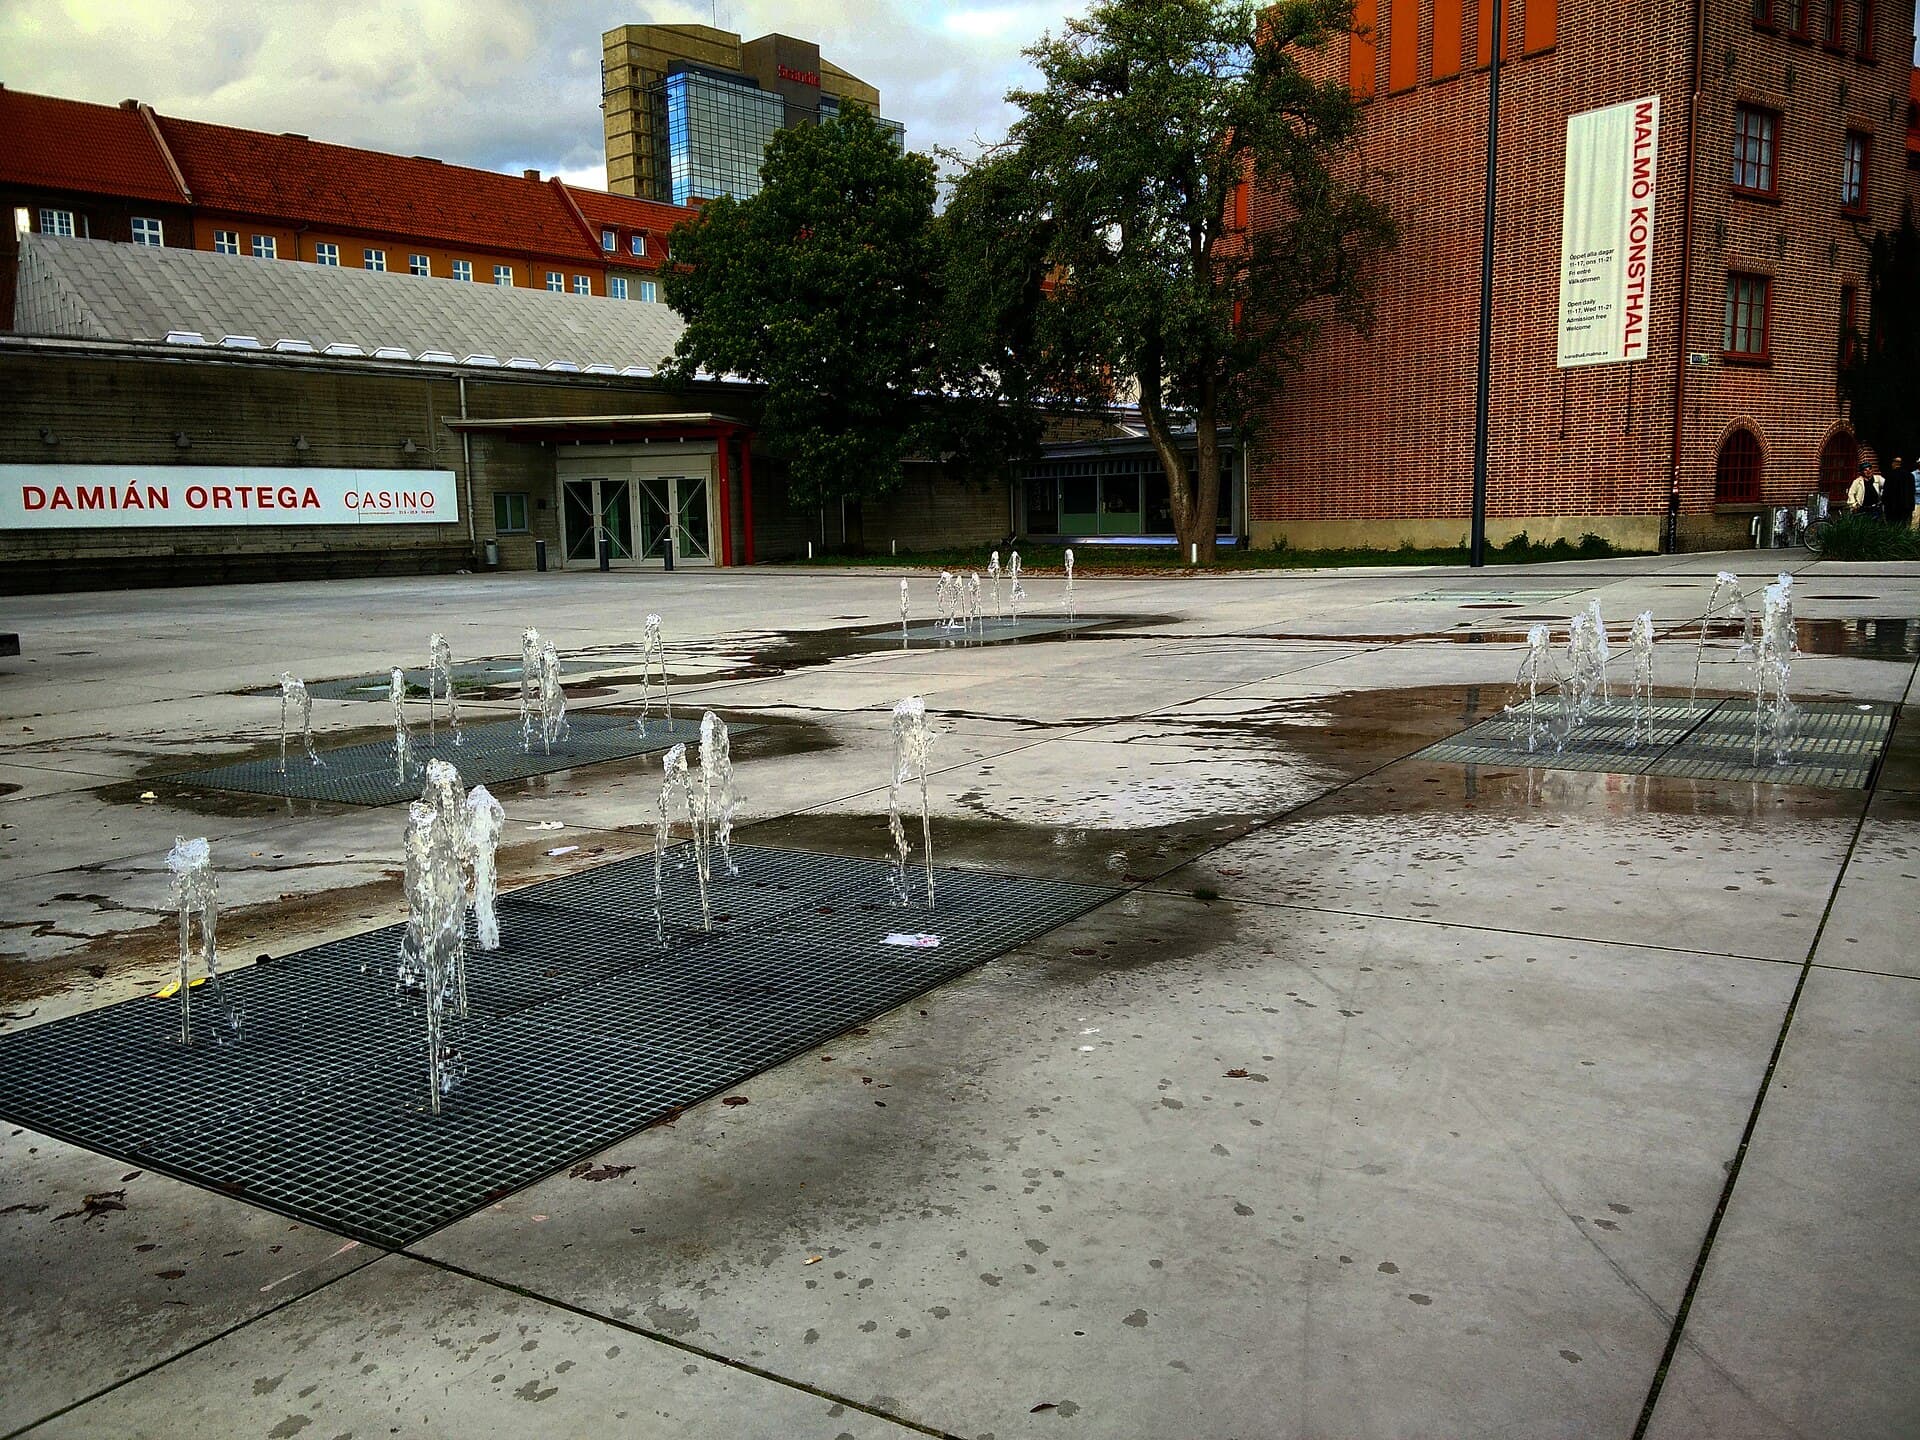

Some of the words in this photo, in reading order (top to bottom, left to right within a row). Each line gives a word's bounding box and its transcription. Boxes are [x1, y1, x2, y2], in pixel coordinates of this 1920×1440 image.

[1631, 101, 1654, 200] MALMÖ
[1623, 206, 1649, 358] KONSTHALL
[22, 480, 168, 511] DAMIÁN
[185, 485, 321, 509] ORTEGA
[344, 491, 434, 509] CASINO
